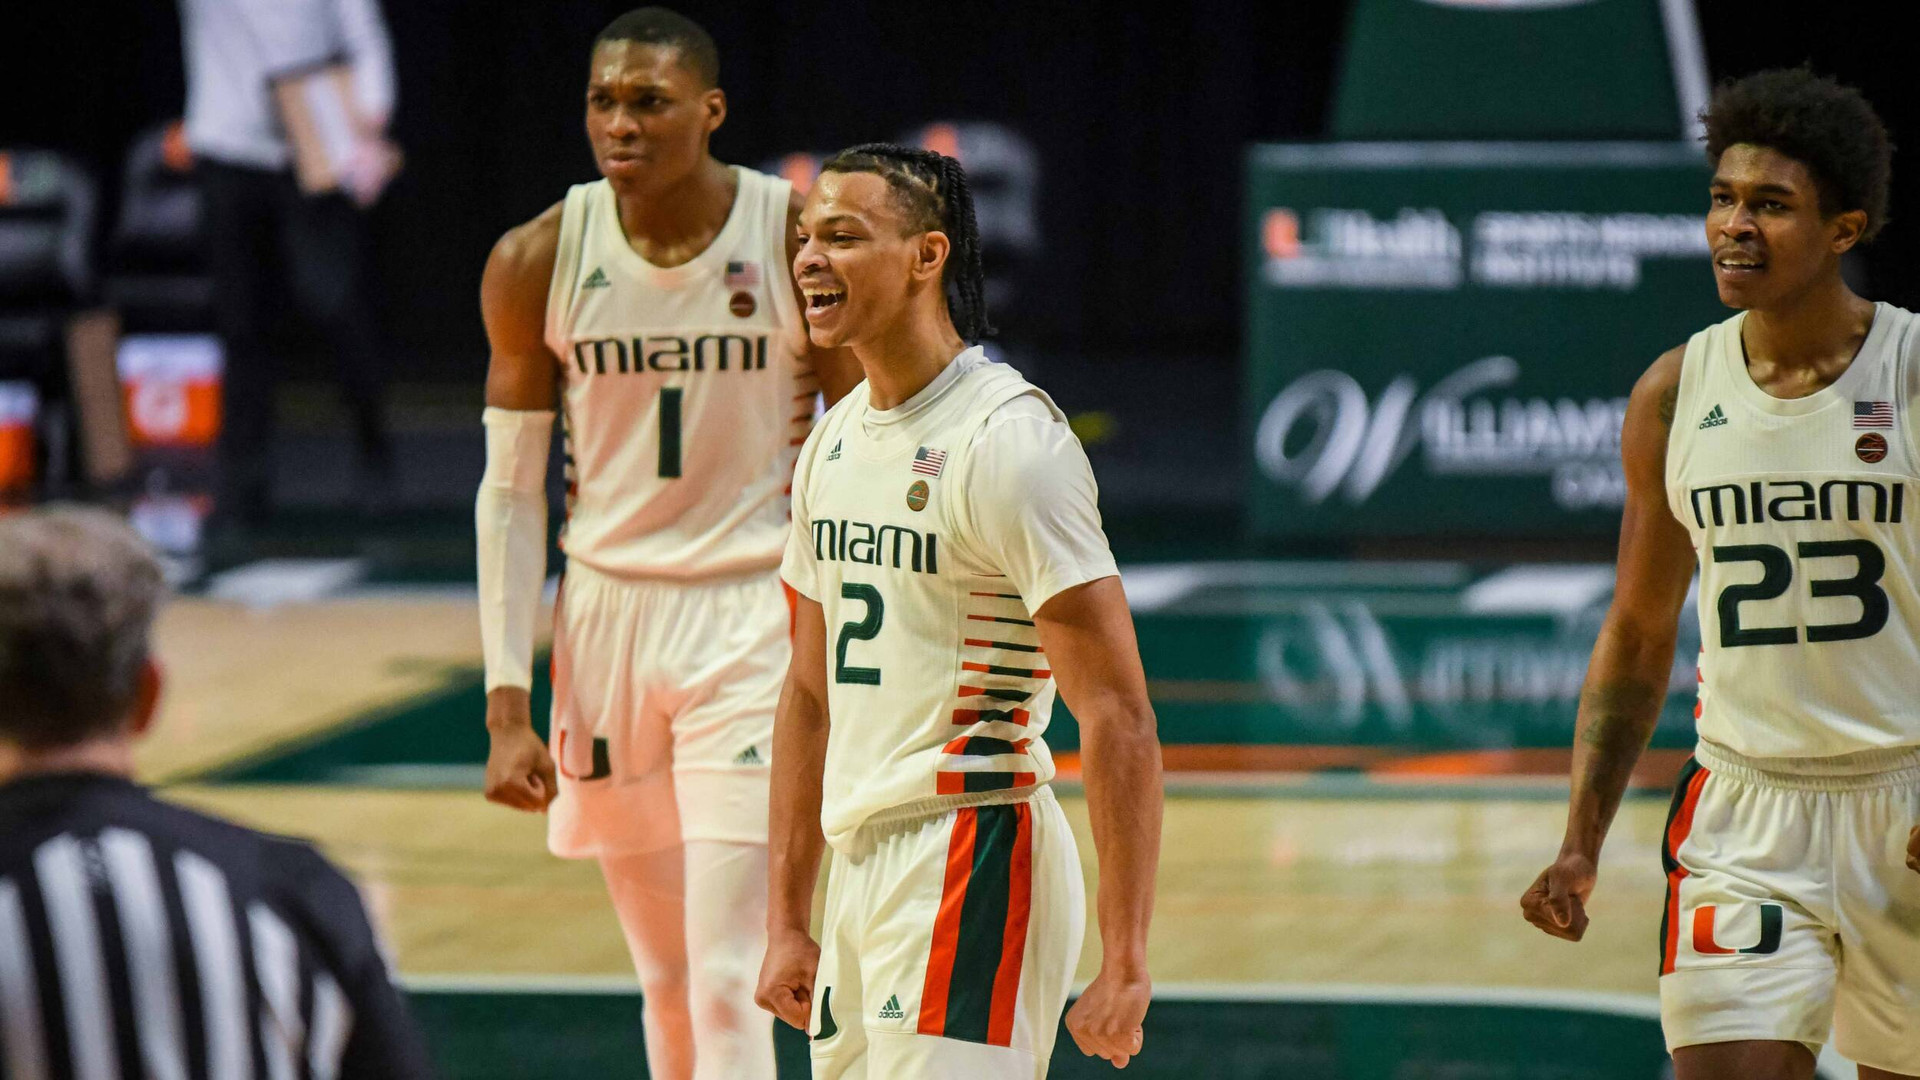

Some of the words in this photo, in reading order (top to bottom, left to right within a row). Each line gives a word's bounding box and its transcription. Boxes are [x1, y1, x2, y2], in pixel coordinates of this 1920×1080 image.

[658, 387, 683, 478] 1
[1699, 417, 1728, 430] adidas
[836, 582, 884, 685] 2
[1713, 539, 1890, 648] 23
[1692, 904, 1783, 955] U
